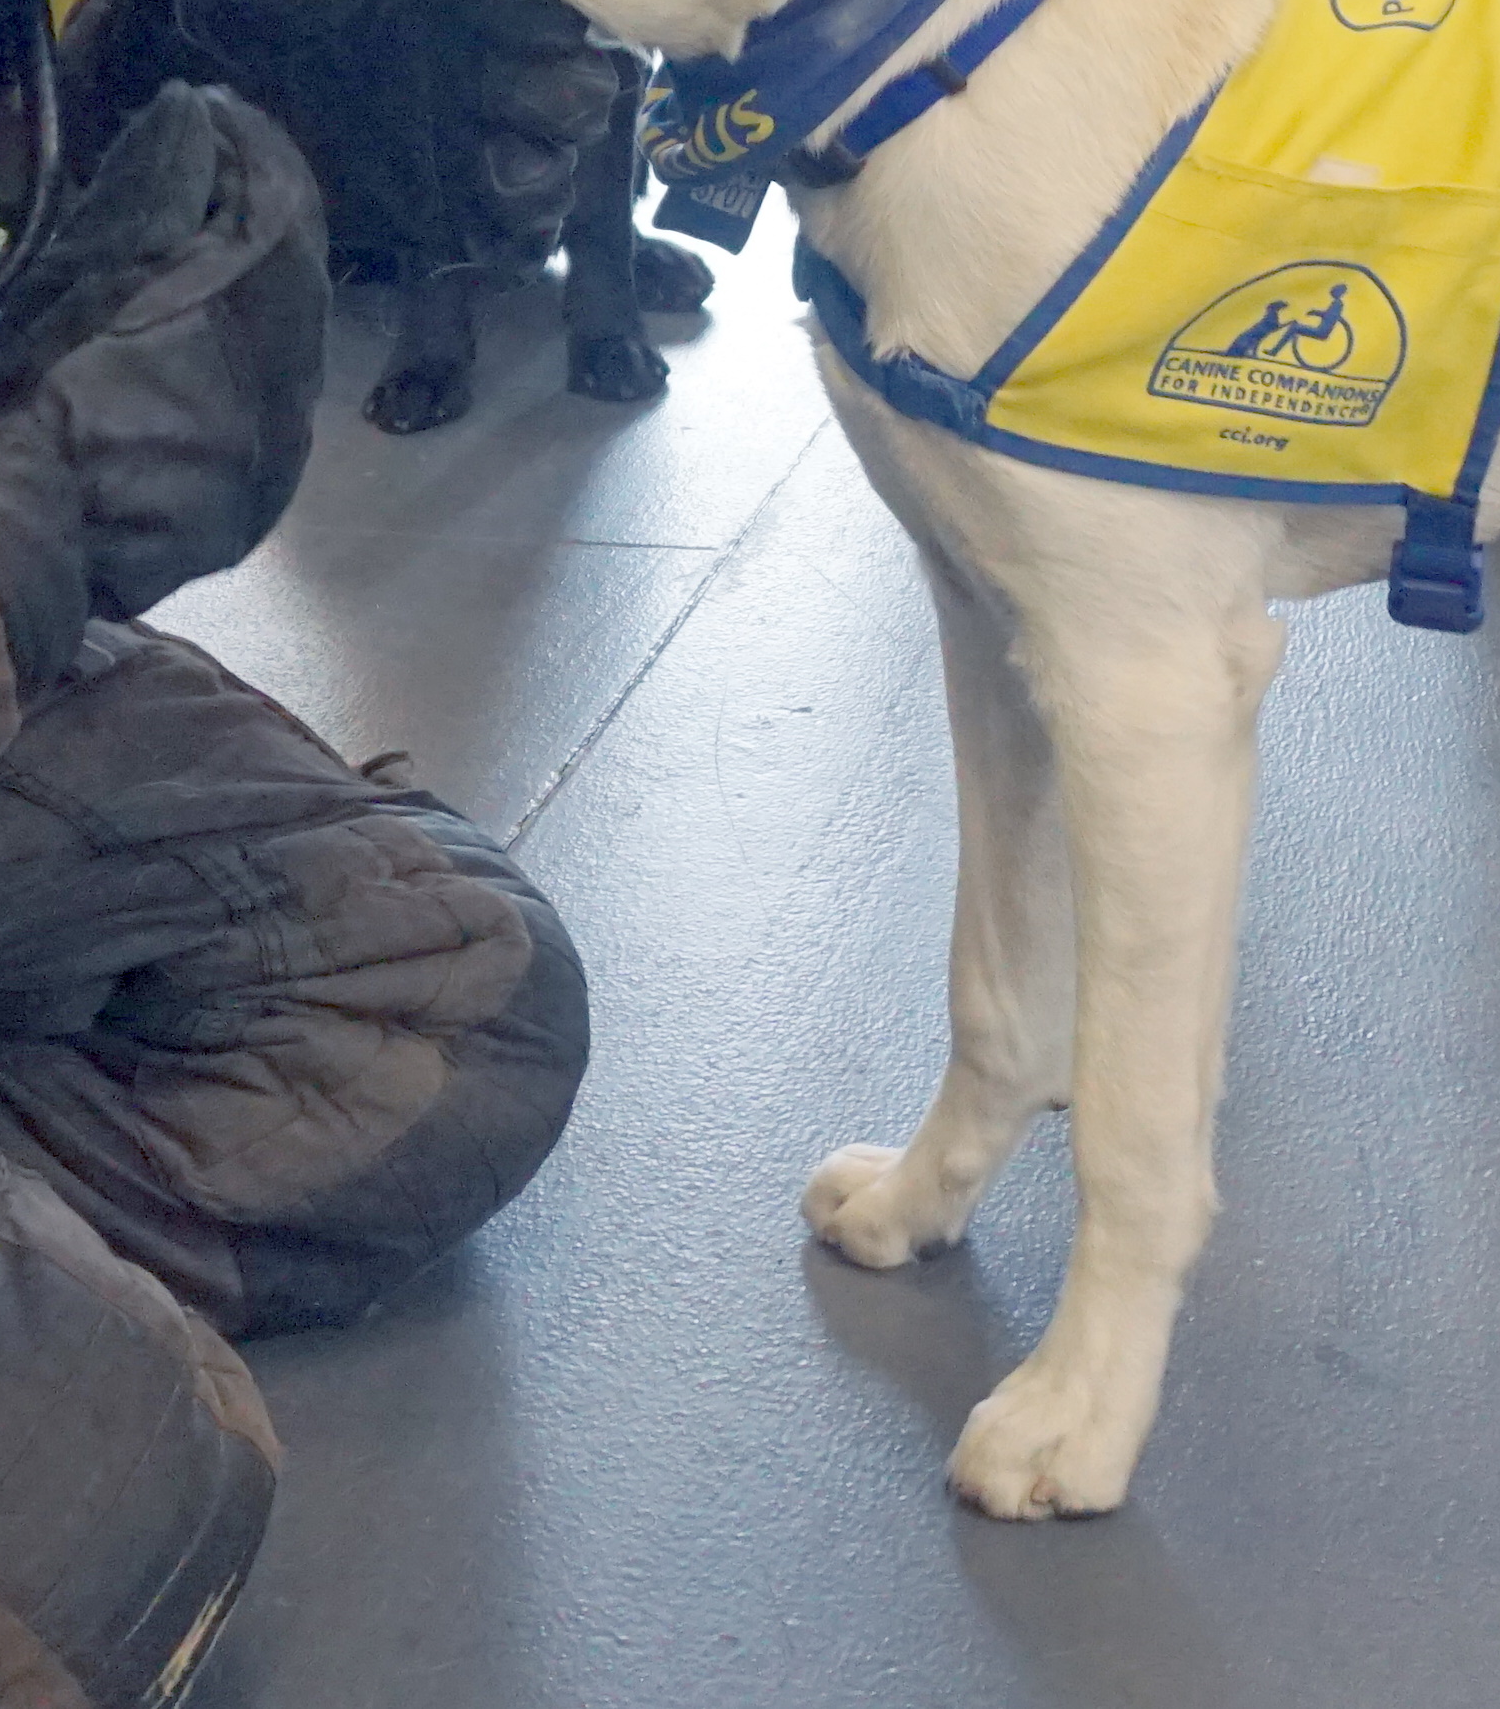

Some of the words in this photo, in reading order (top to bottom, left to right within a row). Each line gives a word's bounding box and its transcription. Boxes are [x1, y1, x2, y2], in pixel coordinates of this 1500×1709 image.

[1160, 374, 1200, 393] FOR
[1164, 355, 1242, 382] CANINE
[1246, 368, 1382, 404] COMPANIONS
[1218, 426, 1290, 452] cci.org
